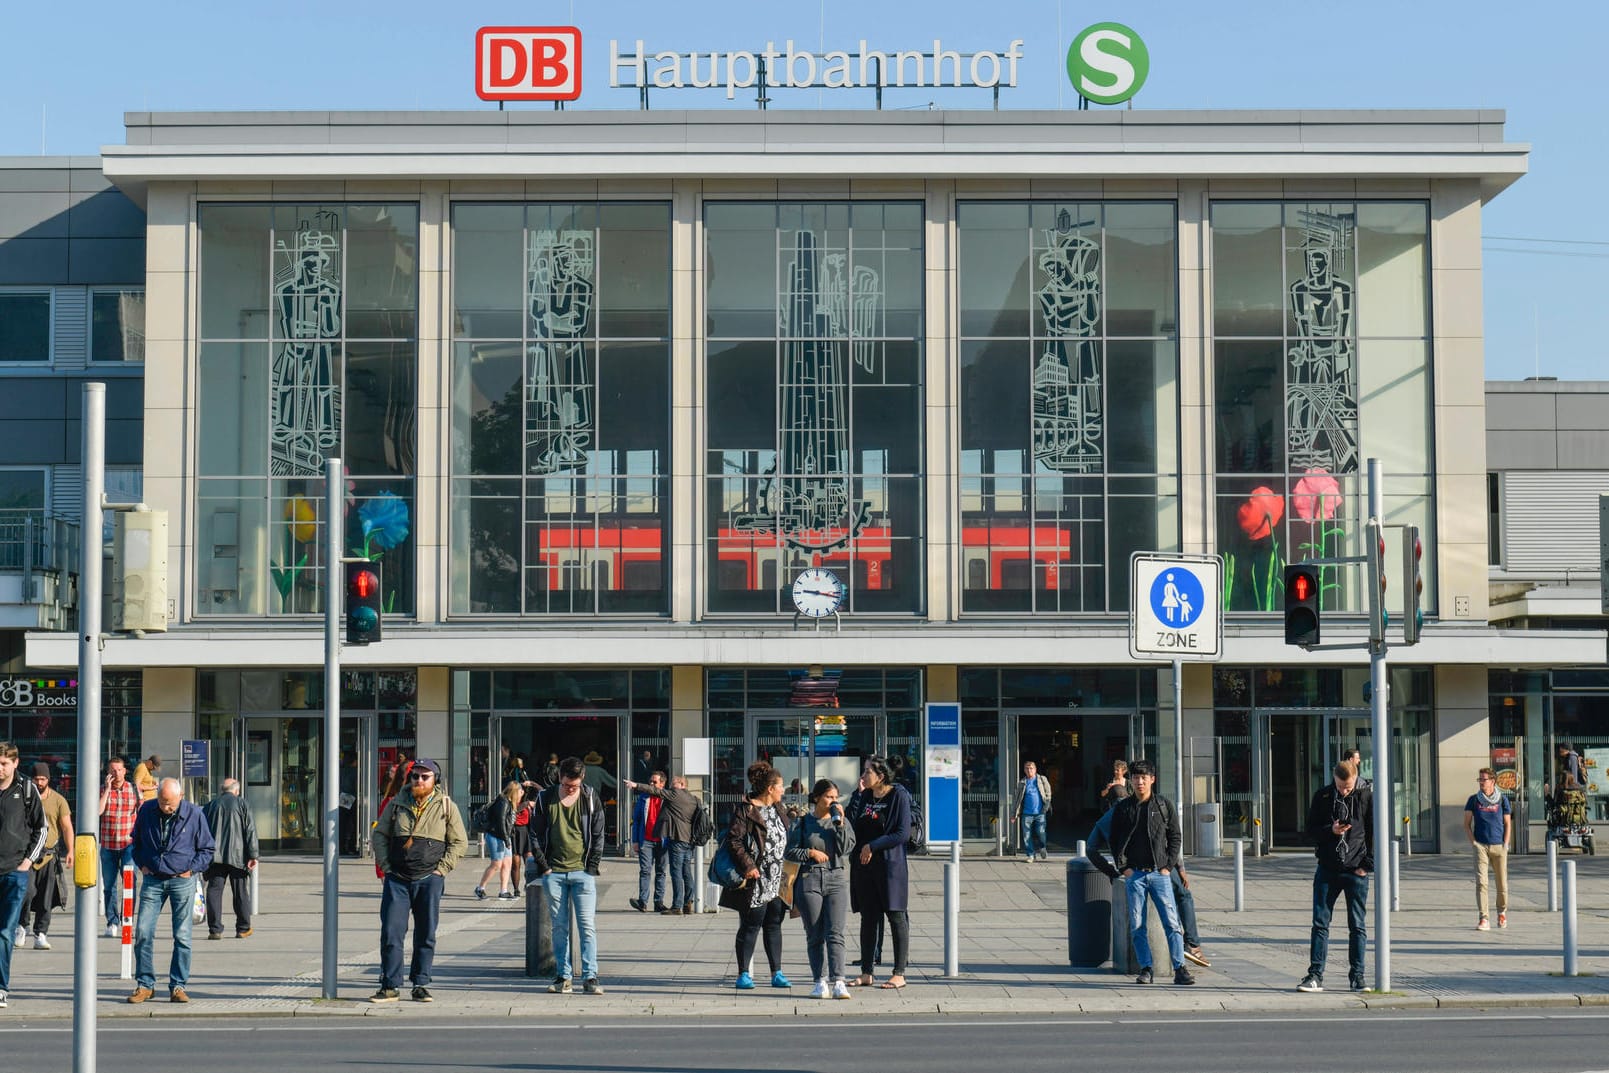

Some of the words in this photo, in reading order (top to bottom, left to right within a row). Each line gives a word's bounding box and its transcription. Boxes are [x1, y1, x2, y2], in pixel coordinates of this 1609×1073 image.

[488, 38, 569, 87] DB
[608, 39, 1023, 100] Hauptbahnhof
[1080, 30, 1136, 97] S
[870, 560, 878, 572] 2
[1156, 632, 1197, 648] ZONE
[37, 693, 77, 706] Books
